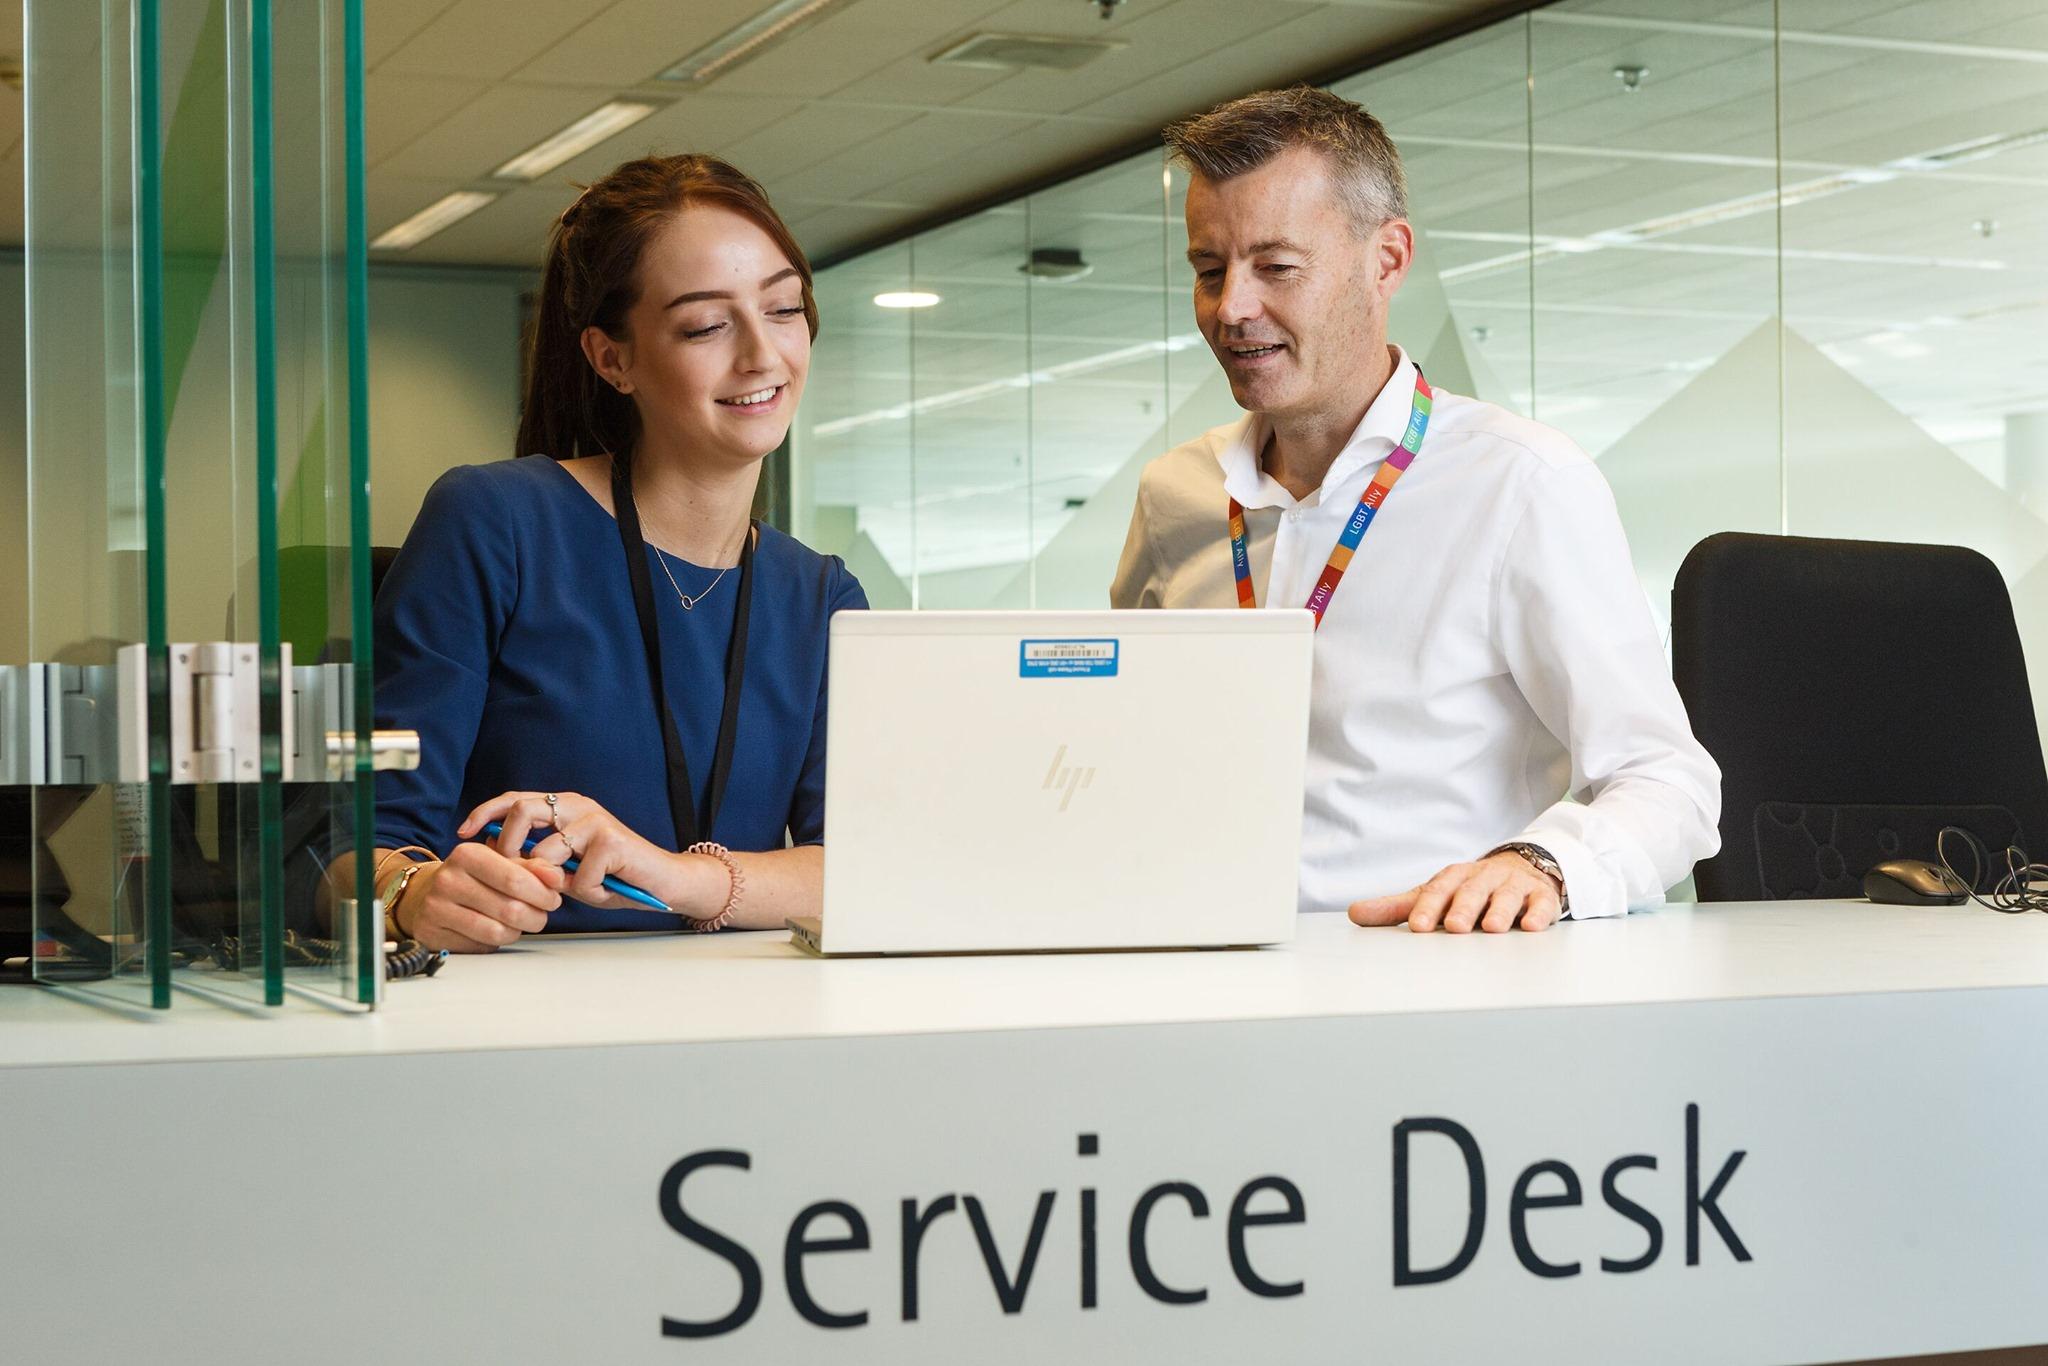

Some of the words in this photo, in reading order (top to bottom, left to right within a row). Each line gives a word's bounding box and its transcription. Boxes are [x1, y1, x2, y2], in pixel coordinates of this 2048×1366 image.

[1404, 424, 1420, 449] LGBT
[1413, 407, 1426, 426] Ally
[1349, 508, 1369, 535] LGBT
[1363, 488, 1382, 510] Ally
[1236, 548, 1244, 567] Ally
[1315, 582, 1331, 603] Ally
[1041, 744, 1096, 812] hp
[659, 1135, 1305, 1339] Service
[1393, 1104, 1752, 1287] Desk
